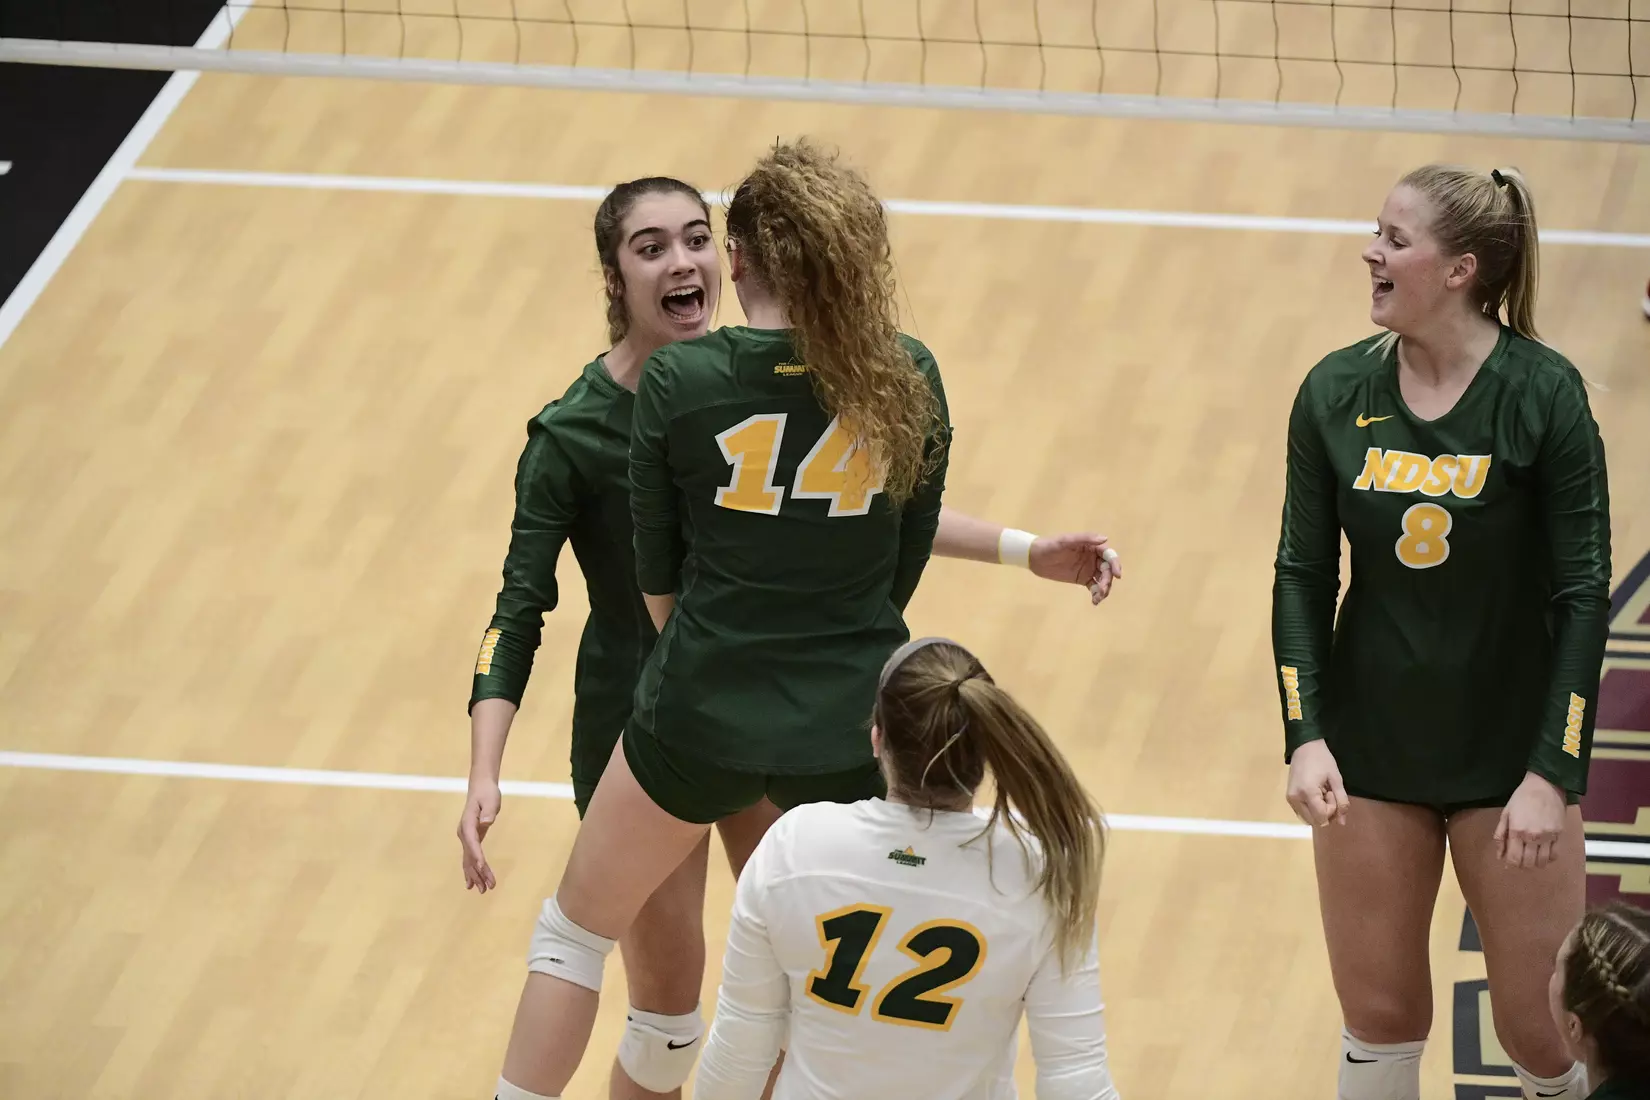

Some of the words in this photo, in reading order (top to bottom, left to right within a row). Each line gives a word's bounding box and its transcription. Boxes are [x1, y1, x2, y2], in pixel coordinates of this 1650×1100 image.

[714, 413, 889, 517] 14
[1352, 447, 1491, 499] NDSU
[1395, 502, 1453, 568] 8
[1280, 665, 1303, 721] BISON
[1562, 692, 1586, 759] BISON
[887, 851, 926, 865] SUMMIT
[805, 902, 988, 1032] 12
